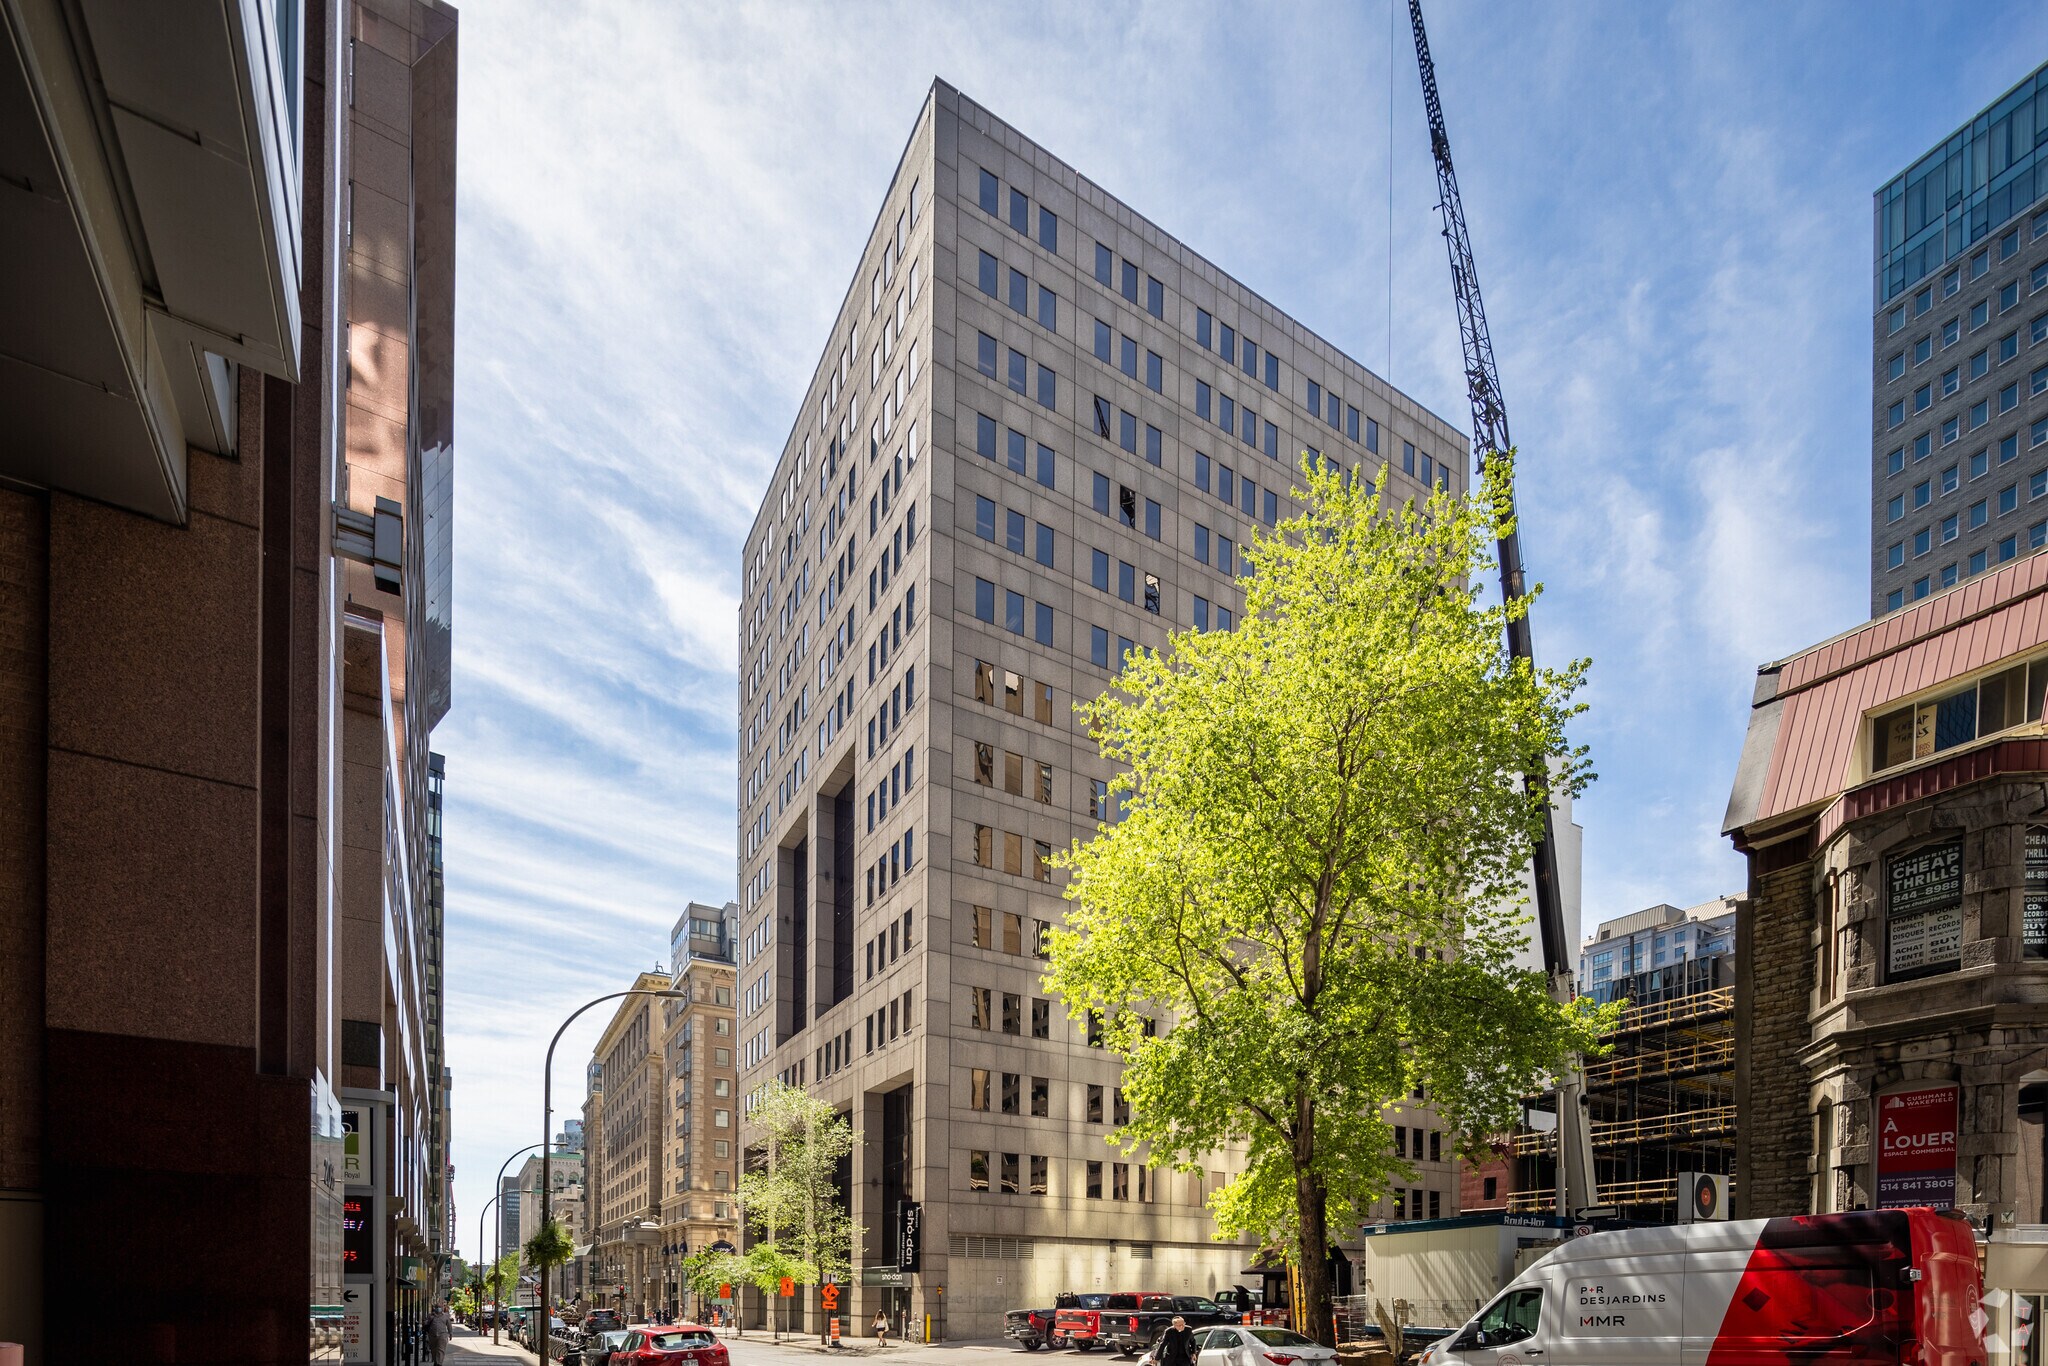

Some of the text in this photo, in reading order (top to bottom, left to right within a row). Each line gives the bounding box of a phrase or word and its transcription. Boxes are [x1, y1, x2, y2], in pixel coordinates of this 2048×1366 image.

[2025, 835, 2048, 845] CHEA
[1893, 846, 1960, 869] ENTREPRISES
[1893, 852, 1960, 879] CHEAP
[1893, 865, 1959, 892] THRILLS
[1893, 880, 1959, 903] 844-8988
[2024, 910, 2048, 918] ECORDS
[1893, 921, 1925, 933] COMPACTS
[1929, 919, 1960, 932] RECORDS
[1893, 929, 1925, 941] DISQUES
[1907, 1092, 1946, 1102] CUSHMAN
[1907, 1097, 1954, 1107] WAKEFIELD
[1884, 1117, 1899, 1133] À
[1884, 1131, 1955, 1150] LOUER
[1911, 1147, 1955, 1155] COMMERCIAL
[1881, 1180, 1954, 1191] 514 841 3805
[1580, 1294, 1666, 1305] DESJARDINS
[1580, 1316, 1625, 1327] MMR
